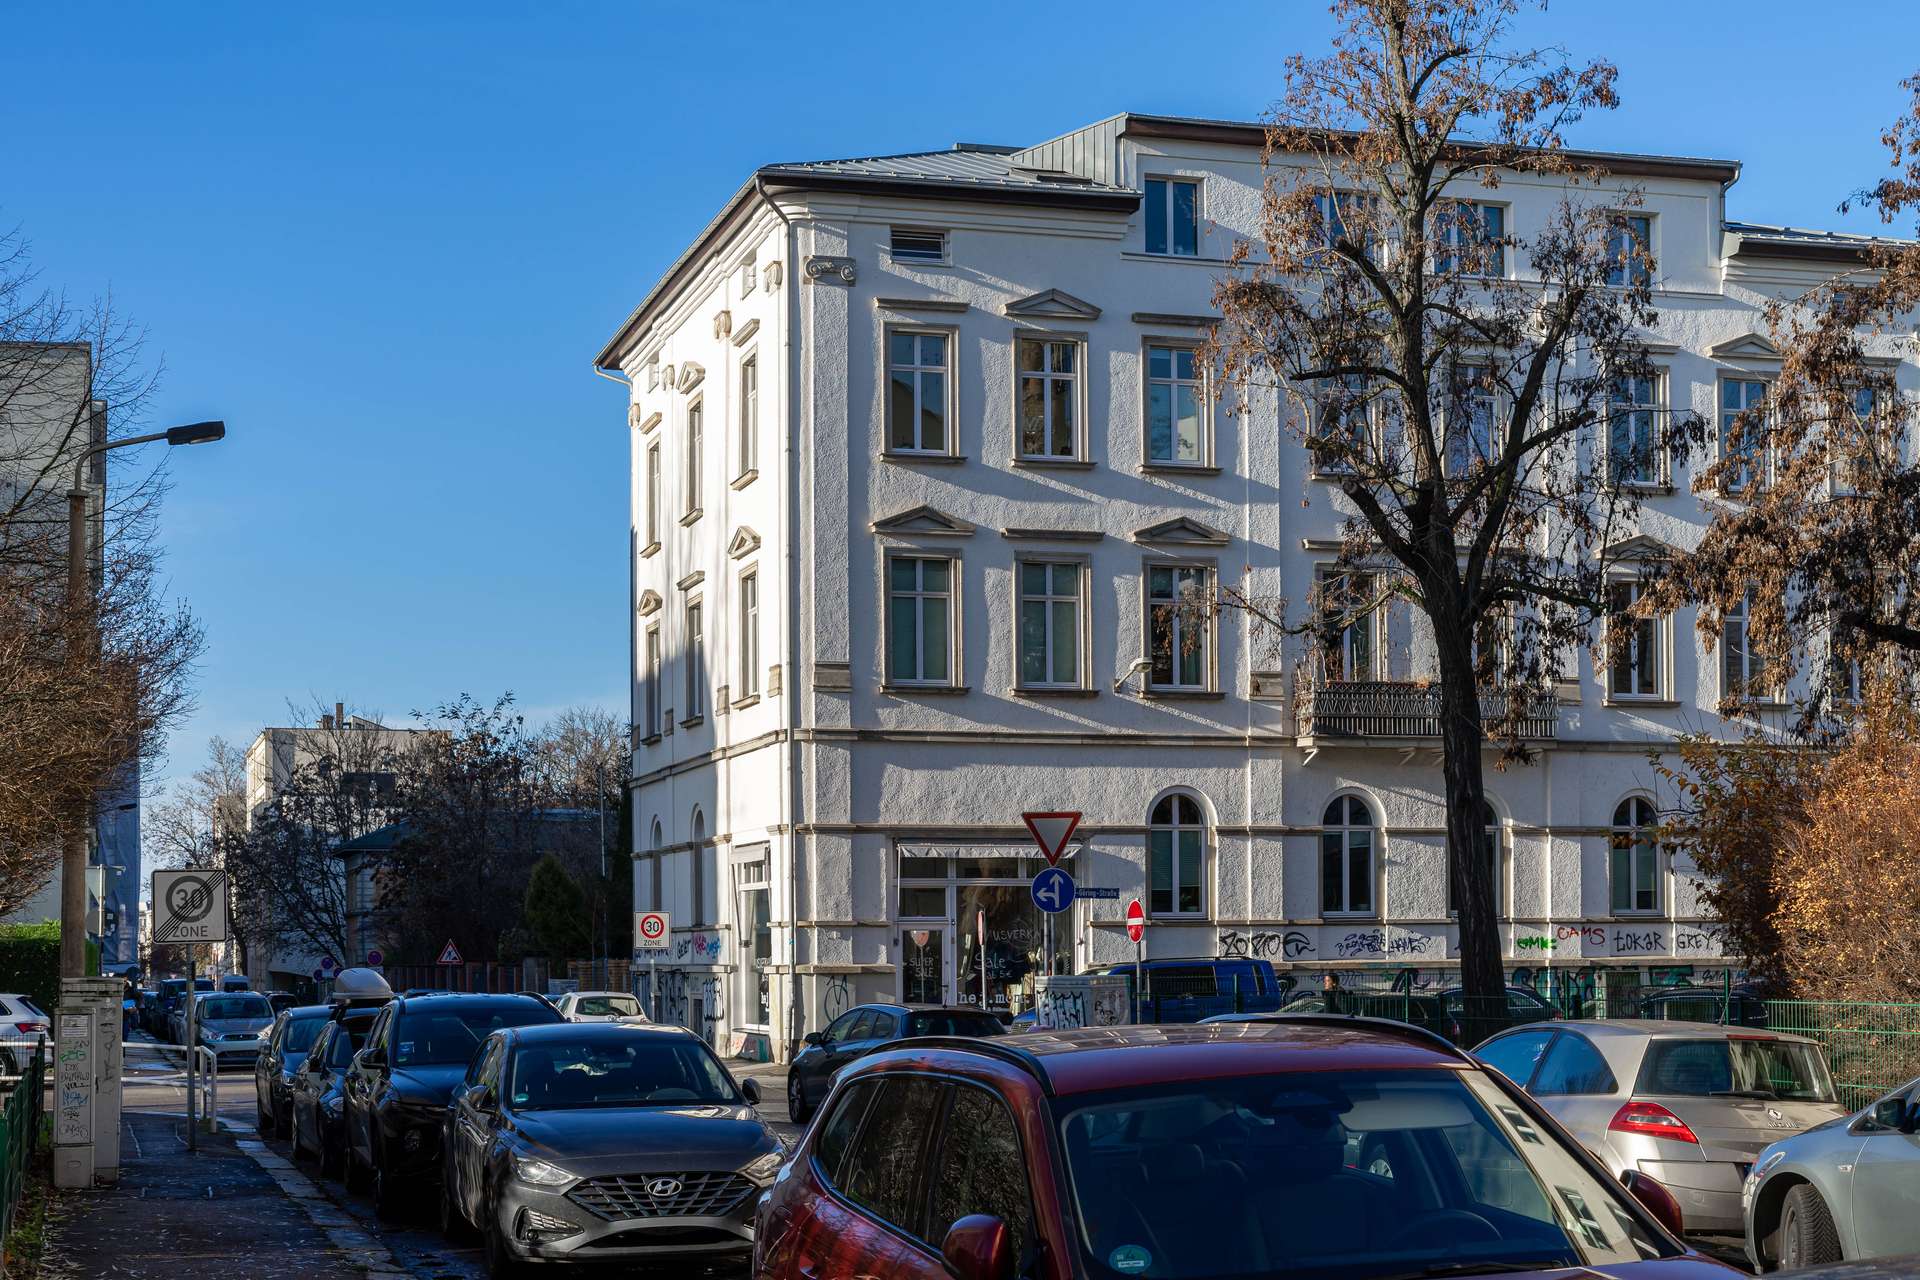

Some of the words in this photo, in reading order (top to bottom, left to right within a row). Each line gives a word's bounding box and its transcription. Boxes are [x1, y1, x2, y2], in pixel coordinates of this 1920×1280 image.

[172, 926, 208, 937] ZONE
[645, 921, 660, 932] 30
[909, 957, 934, 967] SUER
[915, 967, 934, 977] SLE
